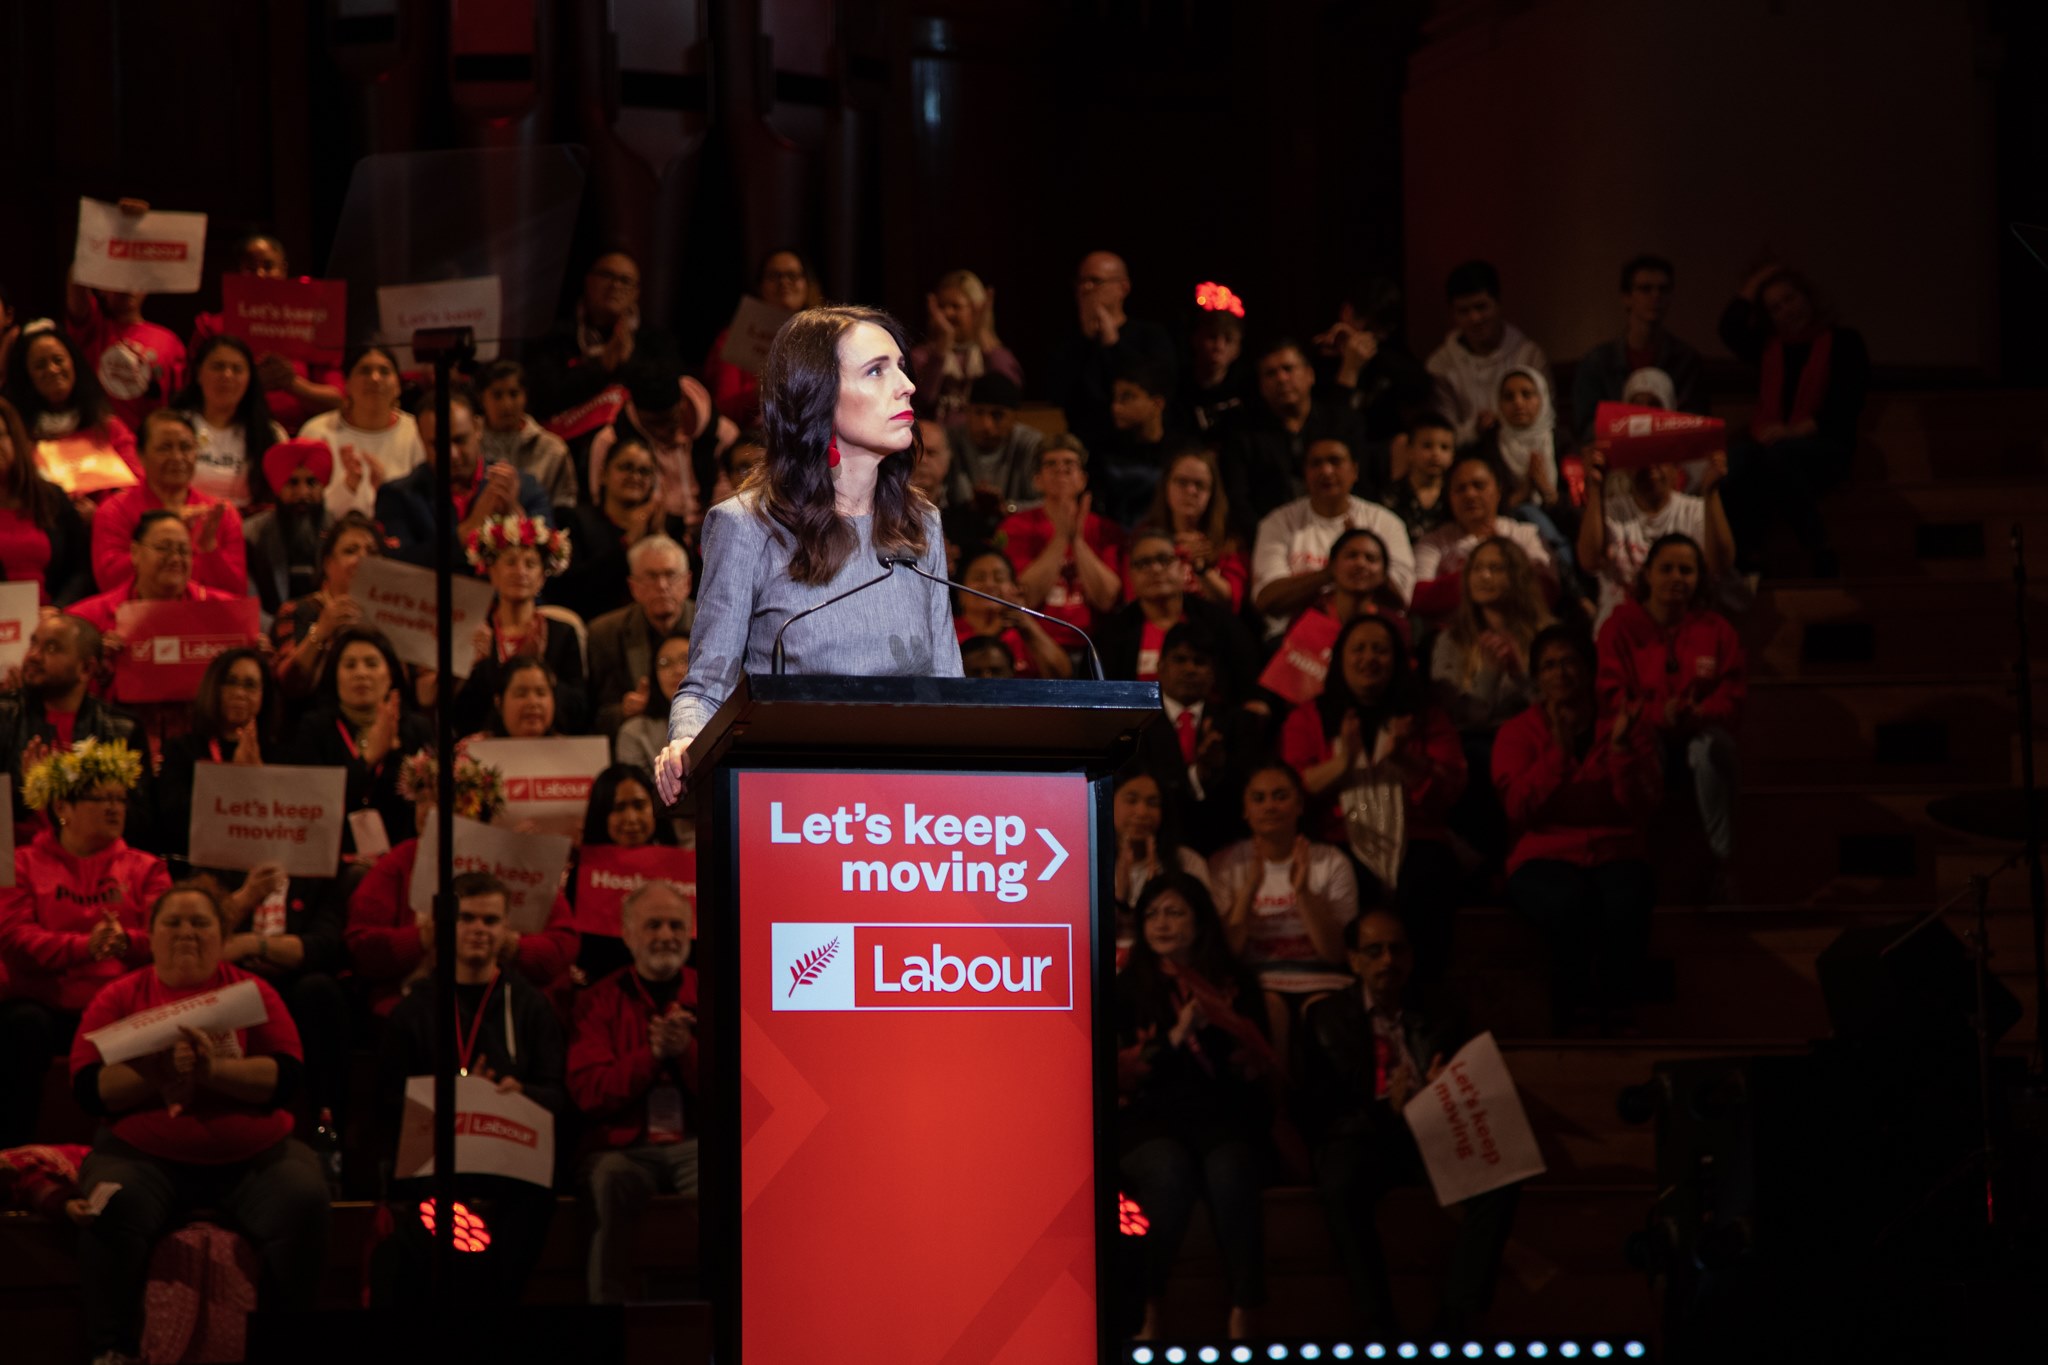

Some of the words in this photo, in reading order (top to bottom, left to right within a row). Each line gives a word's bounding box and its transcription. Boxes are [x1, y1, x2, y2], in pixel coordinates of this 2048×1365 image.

[214, 796, 268, 817] Let's
[272, 799, 324, 822] keep
[534, 780, 590, 799] Labour
[228, 822, 309, 845] moving
[770, 801, 892, 845] Let's
[904, 803, 1027, 856] keep
[453, 854, 491, 873] et's
[494, 862, 545, 887] keep
[842, 850, 1028, 904] moving
[874, 943, 1053, 993] Labour
[472, 1115, 533, 1143] Labour
[1435, 1082, 1474, 1160] moving
[1450, 1060, 1480, 1111] Let's
[1471, 1109, 1501, 1166] keep
